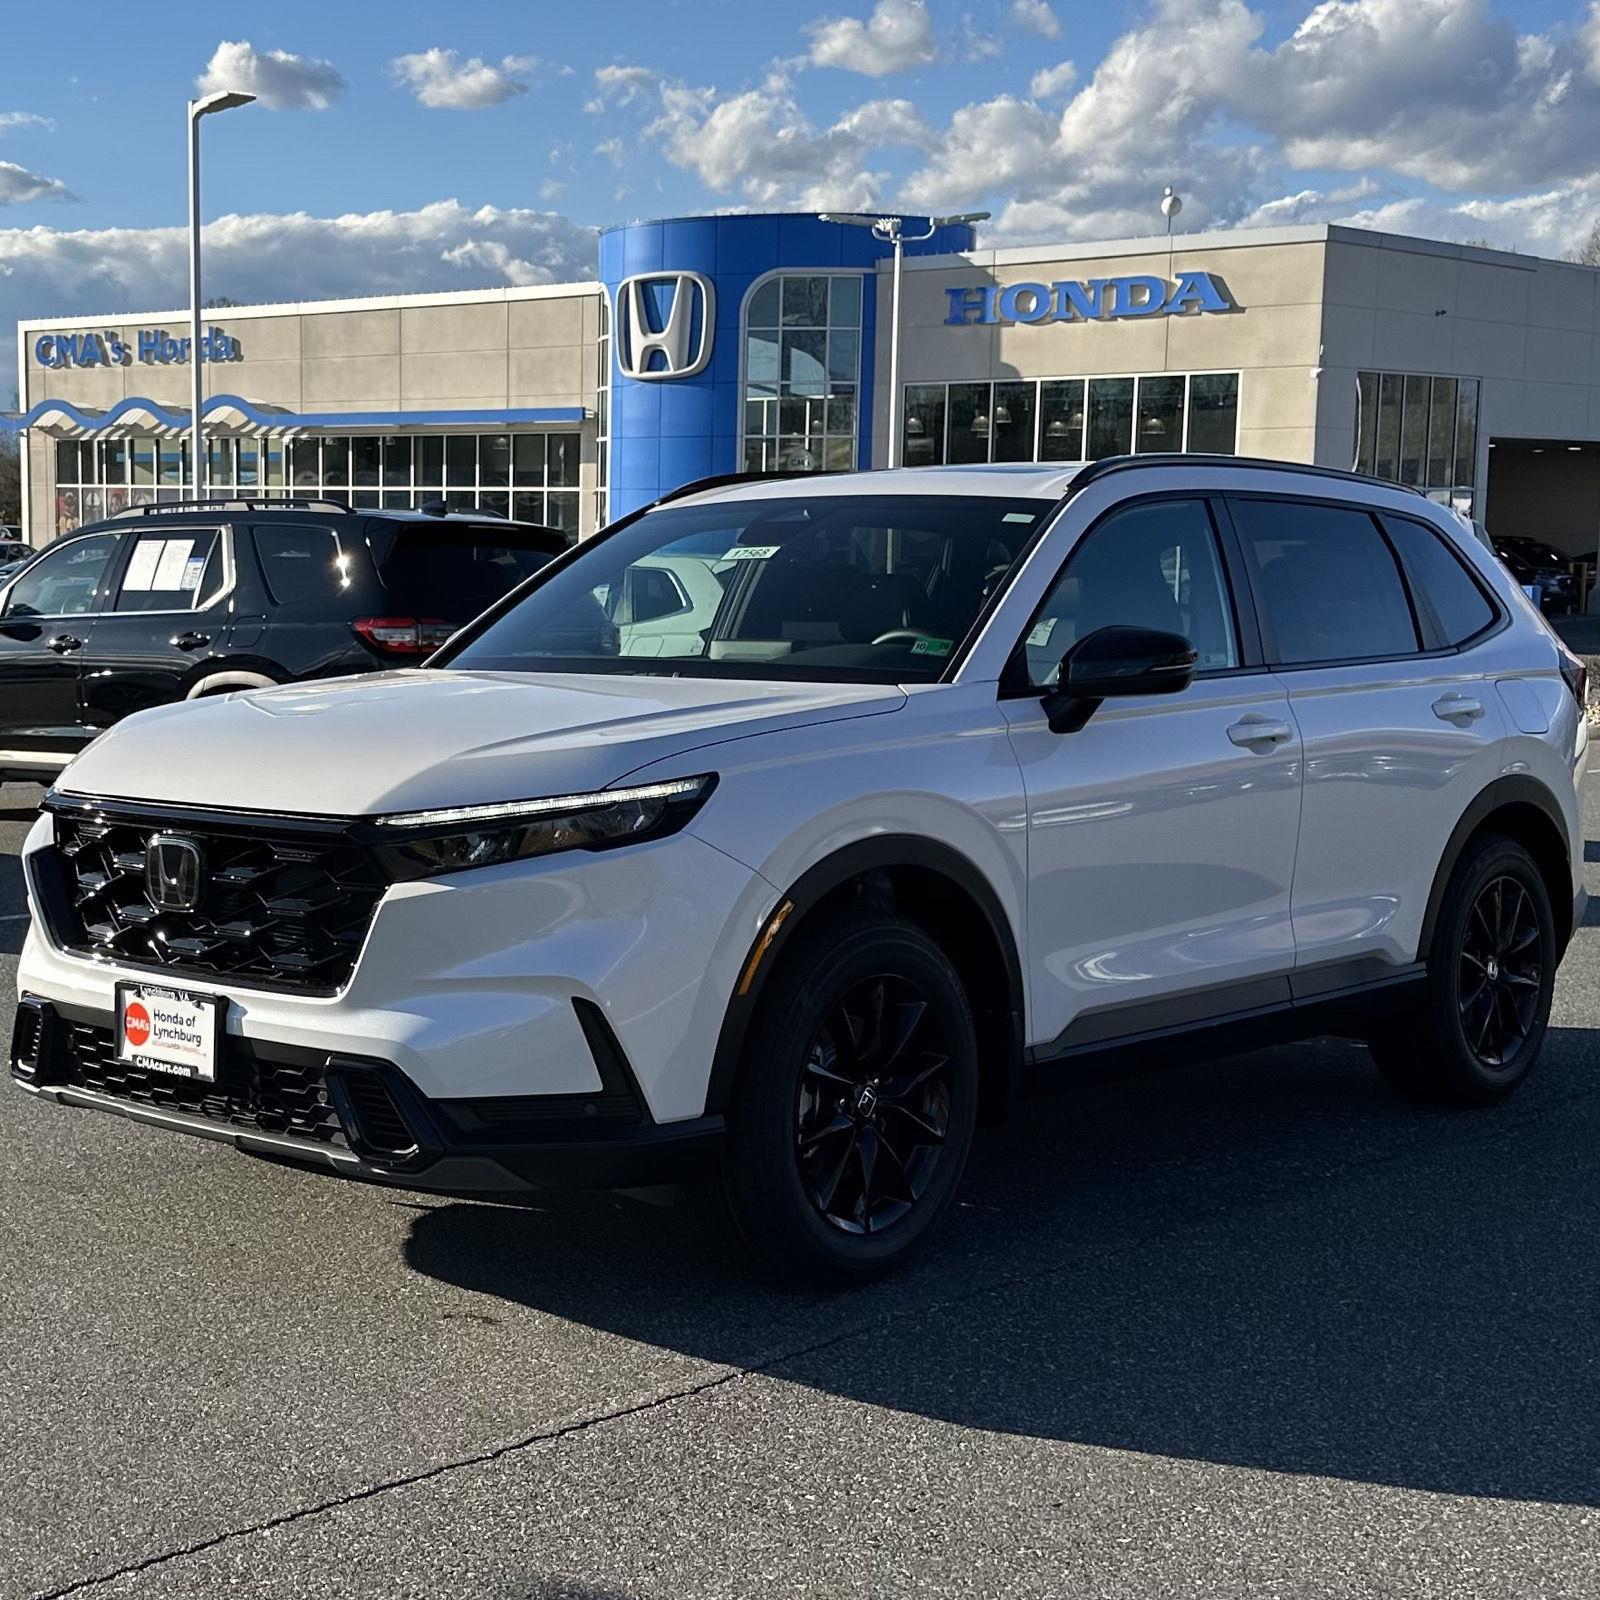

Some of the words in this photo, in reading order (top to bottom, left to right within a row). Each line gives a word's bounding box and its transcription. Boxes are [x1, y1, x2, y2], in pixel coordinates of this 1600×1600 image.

[944, 271, 1230, 326] HONDA
[36, 331, 127, 366] CMA's
[138, 326, 237, 364] Honda
[153, 1009, 184, 1026] Honda
[186, 1016, 196, 1028] of
[153, 1024, 202, 1047] Lynchburg
[136, 1056, 191, 1078] CMAcars.com
